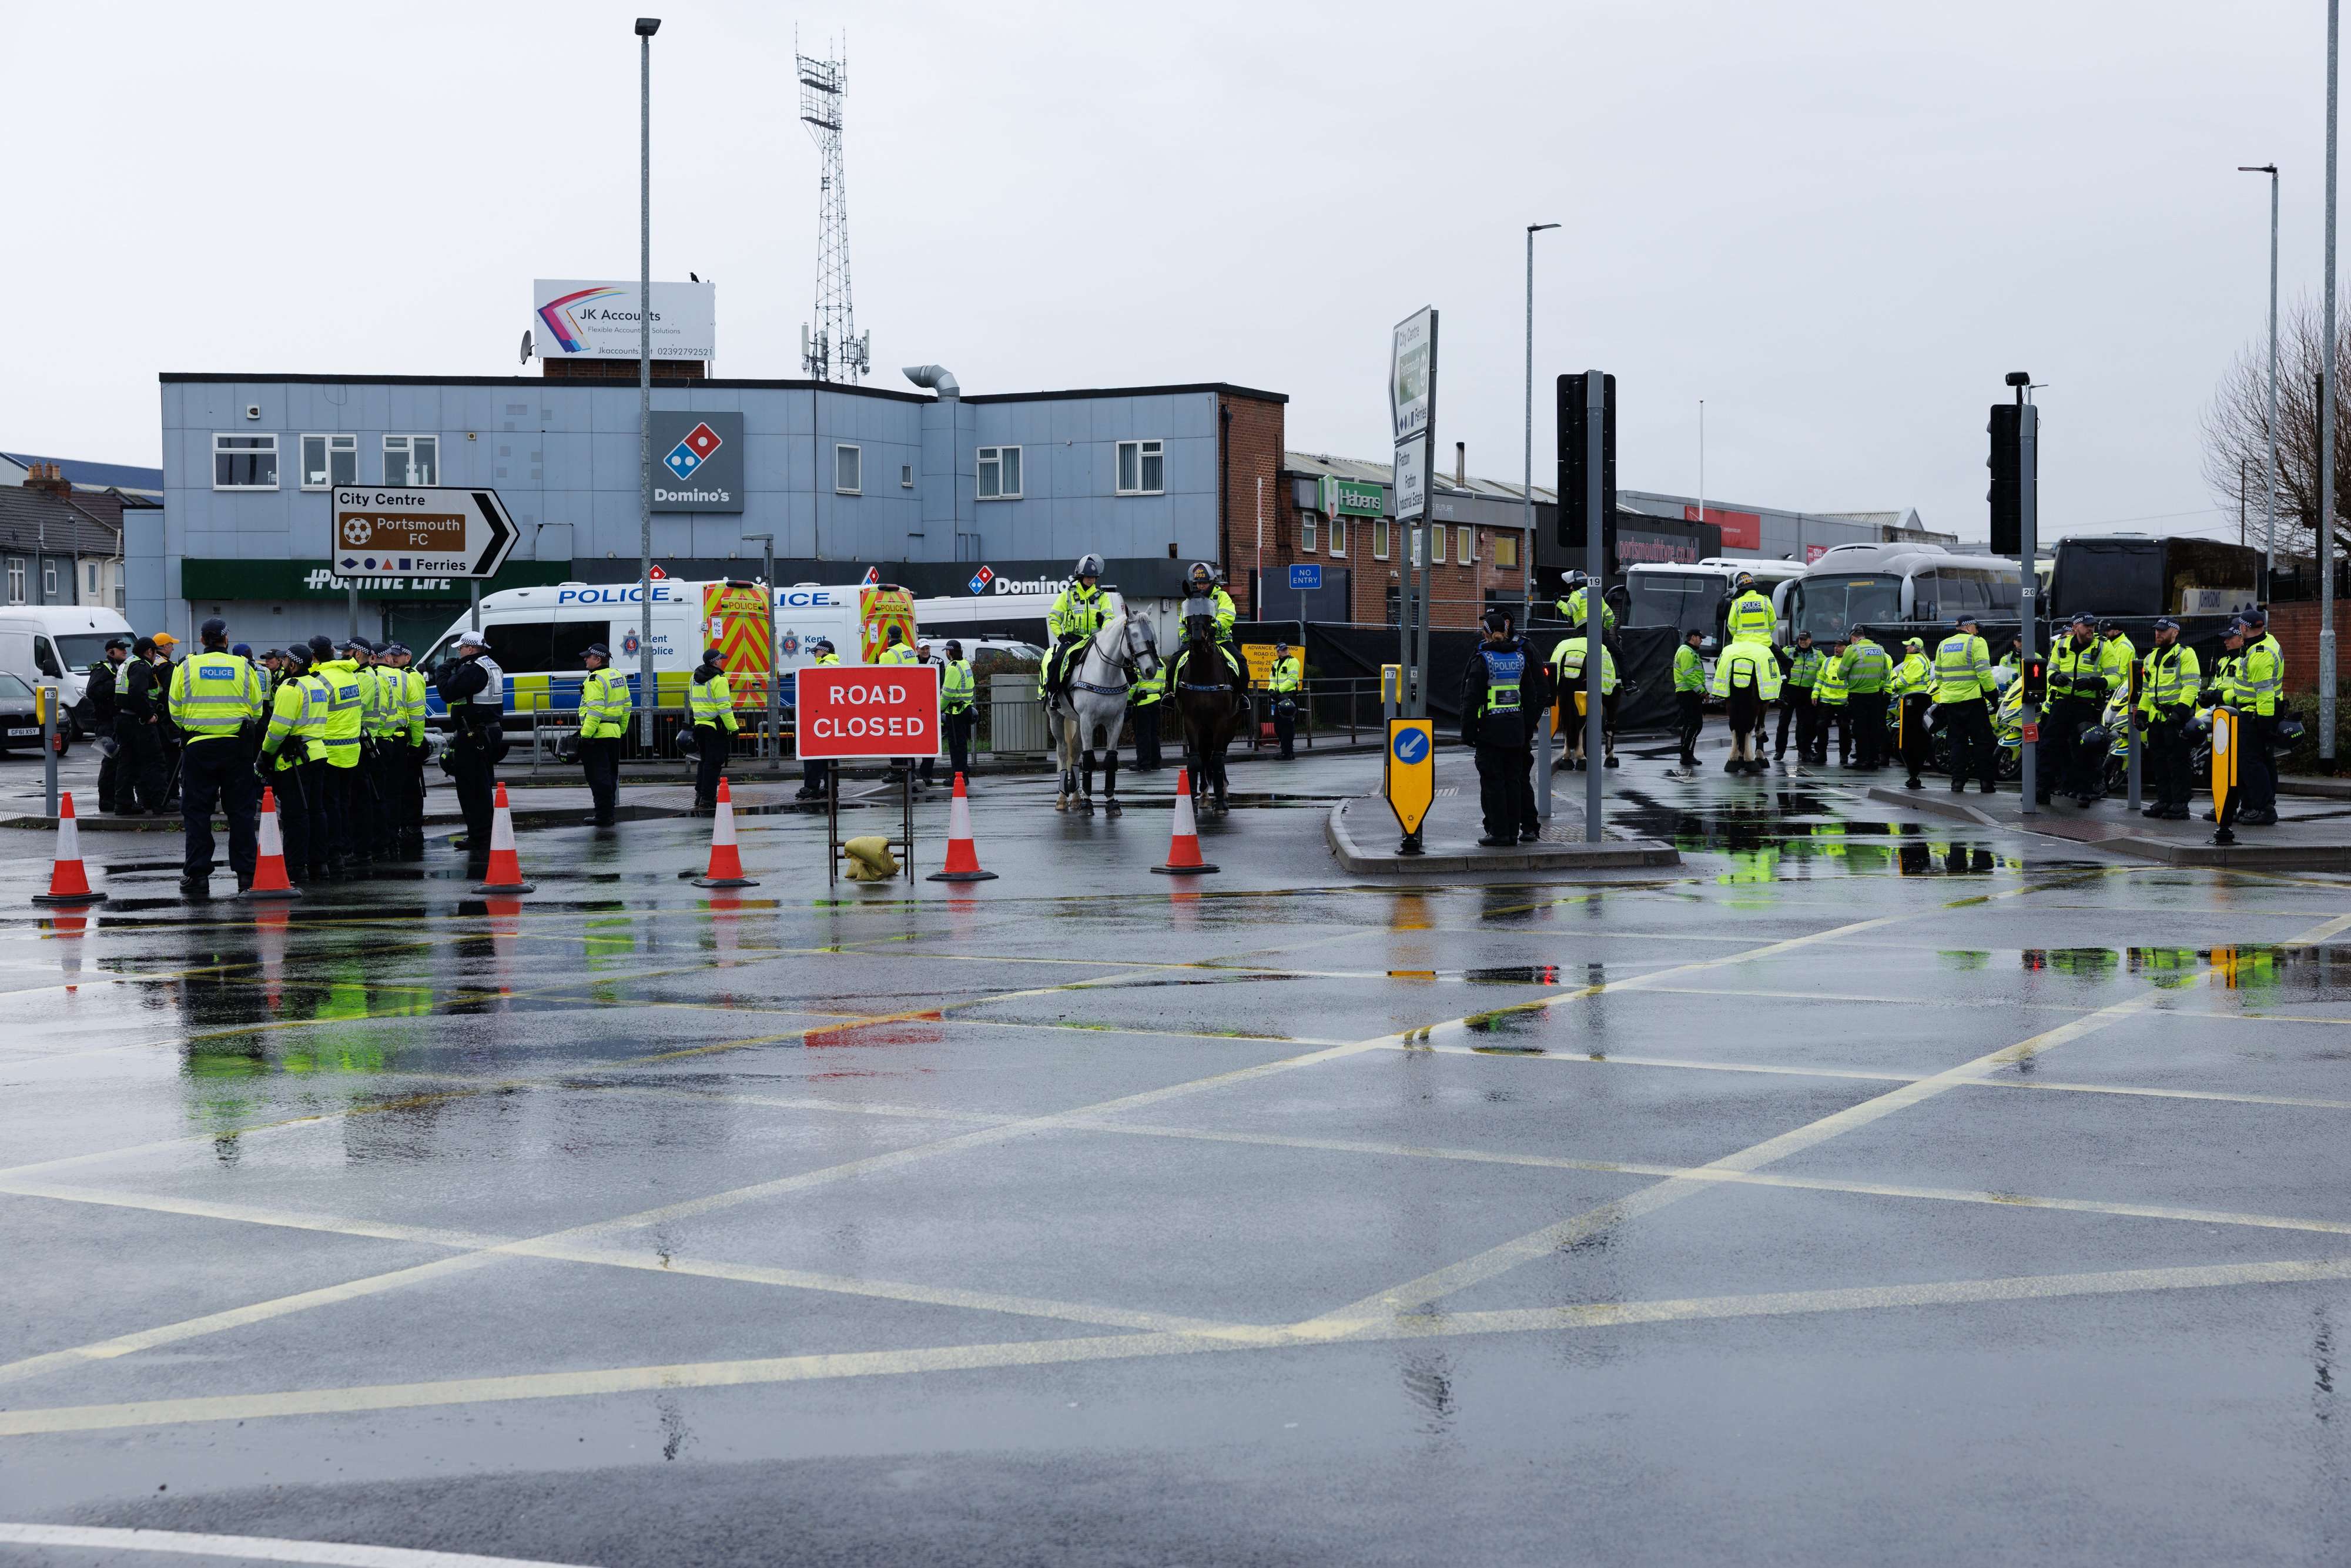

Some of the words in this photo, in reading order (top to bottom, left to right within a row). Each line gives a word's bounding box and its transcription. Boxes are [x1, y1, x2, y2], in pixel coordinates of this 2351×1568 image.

[580, 309, 597, 320] JK
[601, 309, 661, 321] Accouts
[1407, 324, 1419, 342] Centre
[1415, 406, 1426, 423] Ferries
[1399, 452, 1410, 468] Fratton
[1405, 473, 1416, 490] Fratton
[340, 492, 370, 507] City
[375, 493, 425, 505] Centre
[655, 488, 729, 502] Domino's
[1339, 489, 1381, 510] Habens
[1399, 492, 1412, 511] Industrial
[1412, 490, 1423, 507] Estate
[1435, 503, 1454, 512] FUTURE
[377, 518, 460, 531] Portsmouth
[410, 534, 428, 545] FC
[1619, 537, 1696, 564] portsmouthtyre.co.uk
[417, 559, 466, 571] Ferries
[995, 575, 1078, 594] Domino'
[559, 588, 670, 604] POLICE
[774, 593, 830, 607] ICE
[2198, 591, 2221, 611] JOHNSONS
[729, 602, 758, 610] POLICE
[652, 646, 674, 655] olice
[1494, 661, 1520, 671] POLICE
[611, 678, 624, 687] POLICE
[340, 685, 359, 698] POLICE
[830, 685, 906, 705] ROAD
[813, 717, 924, 738] CLOSED
